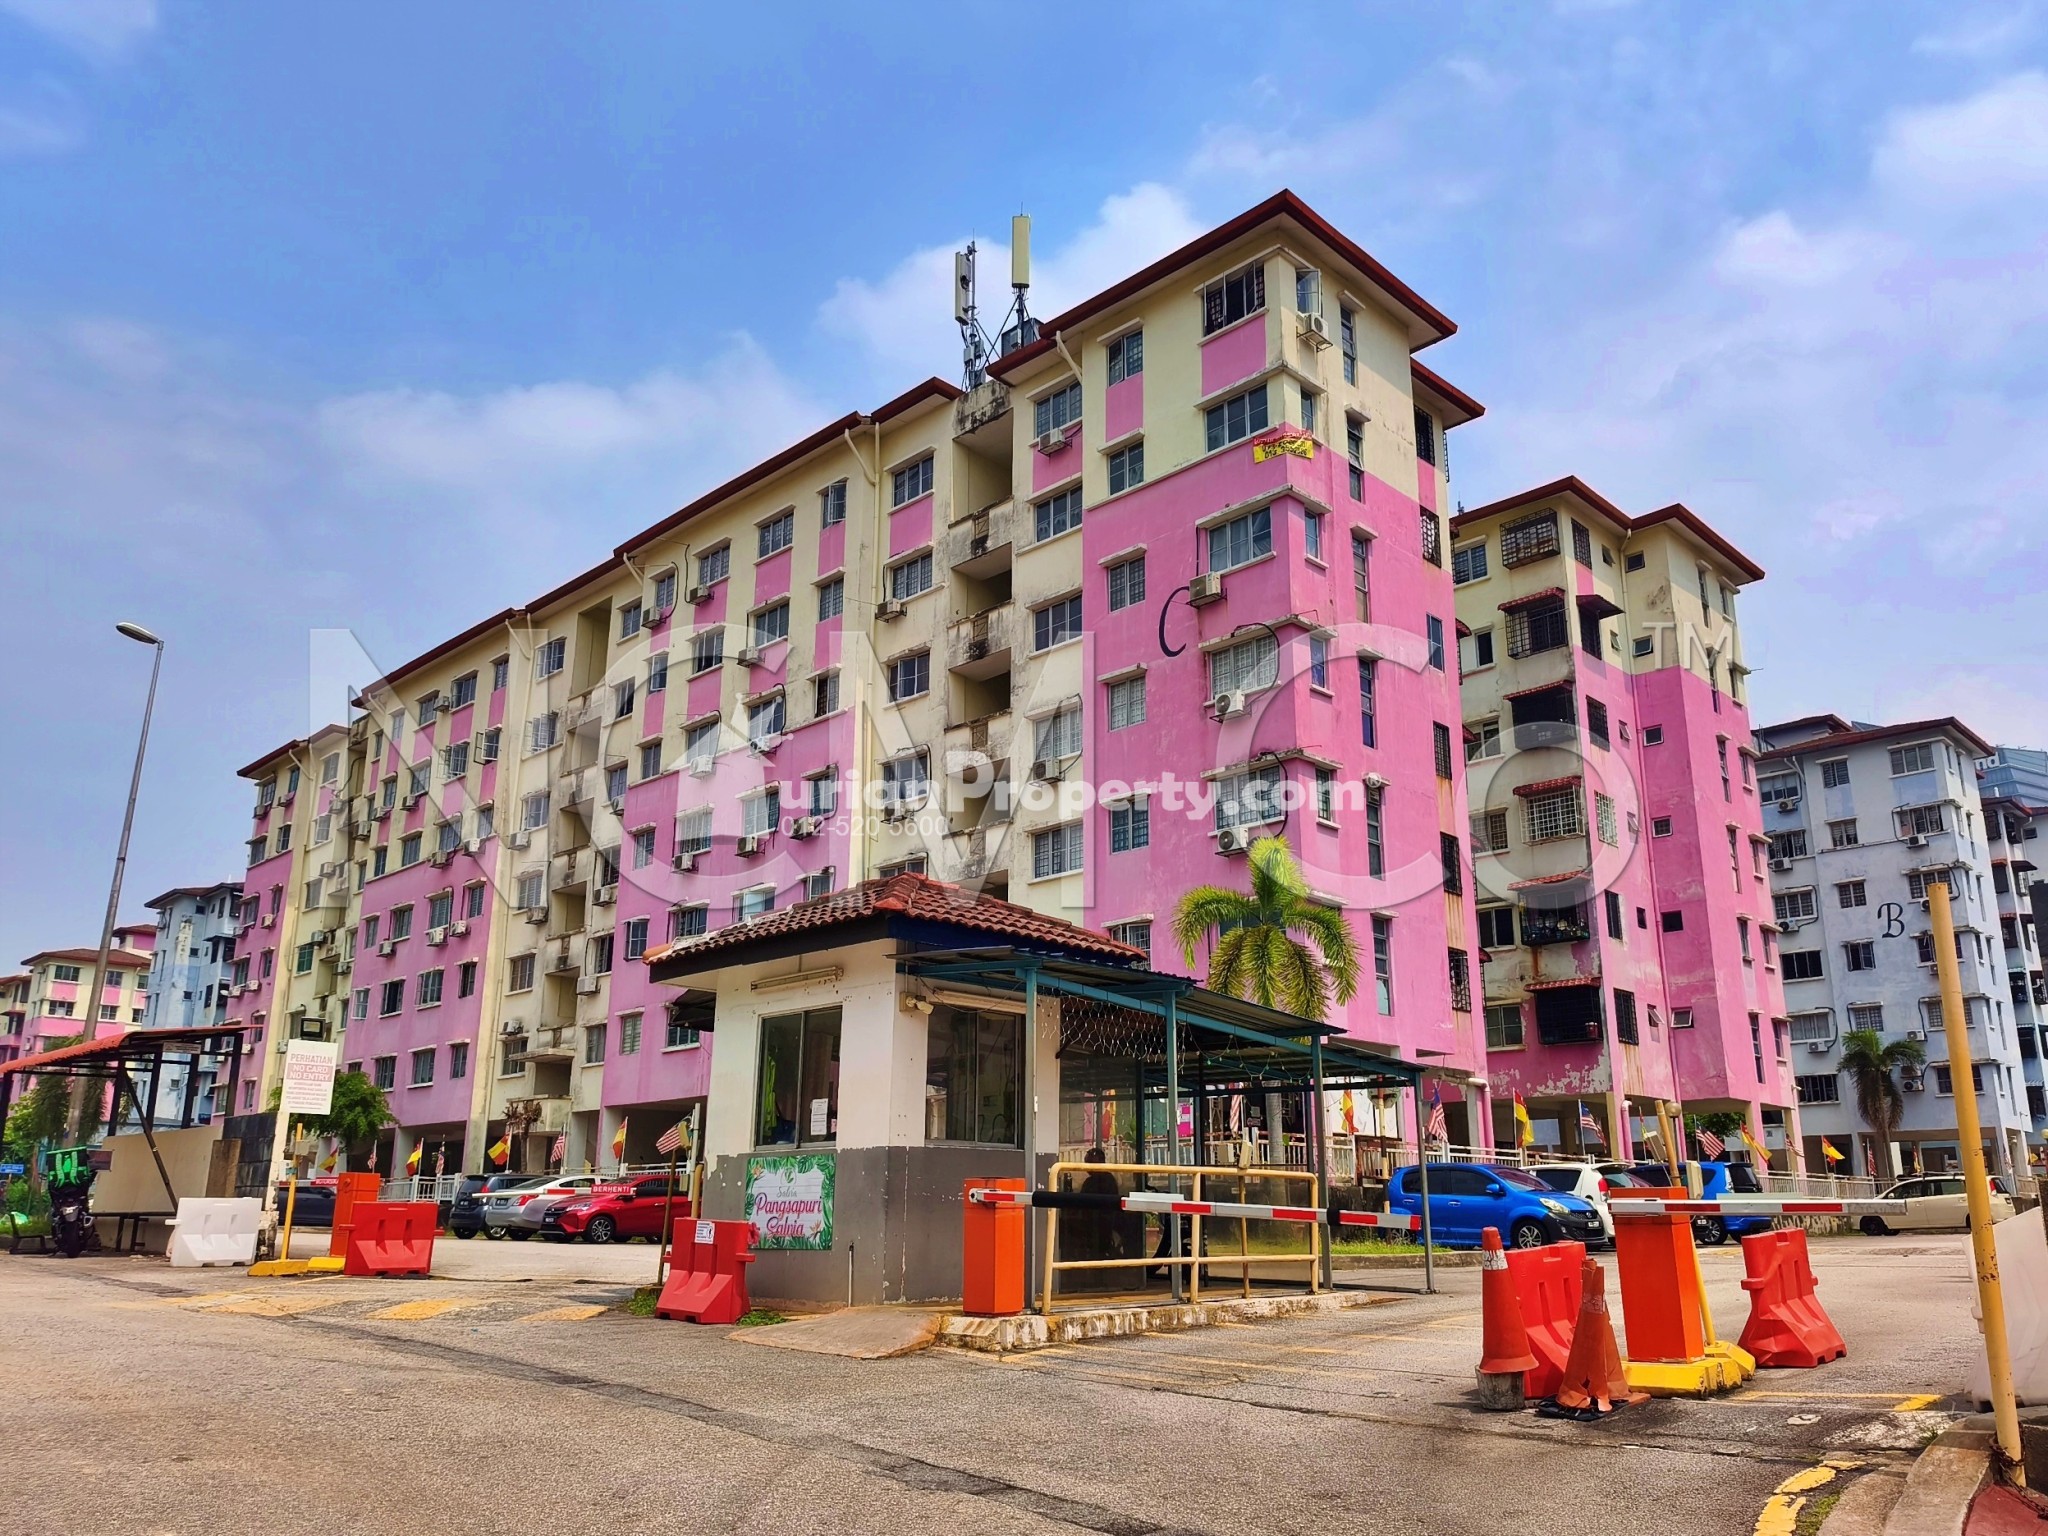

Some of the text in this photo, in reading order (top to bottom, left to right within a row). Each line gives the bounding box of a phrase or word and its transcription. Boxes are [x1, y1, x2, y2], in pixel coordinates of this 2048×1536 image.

[1159, 586, 1190, 657] C
[1877, 902, 1905, 939] B
[291, 1053, 333, 1065] PERHATIAN
[289, 1071, 331, 1081] NO ENTRY
[293, 1064, 328, 1074] NO CARD
[593, 1185, 630, 1193] BERHENTI
[754, 1192, 822, 1221] Pangsapuri
[766, 1216, 805, 1240] Salvia
